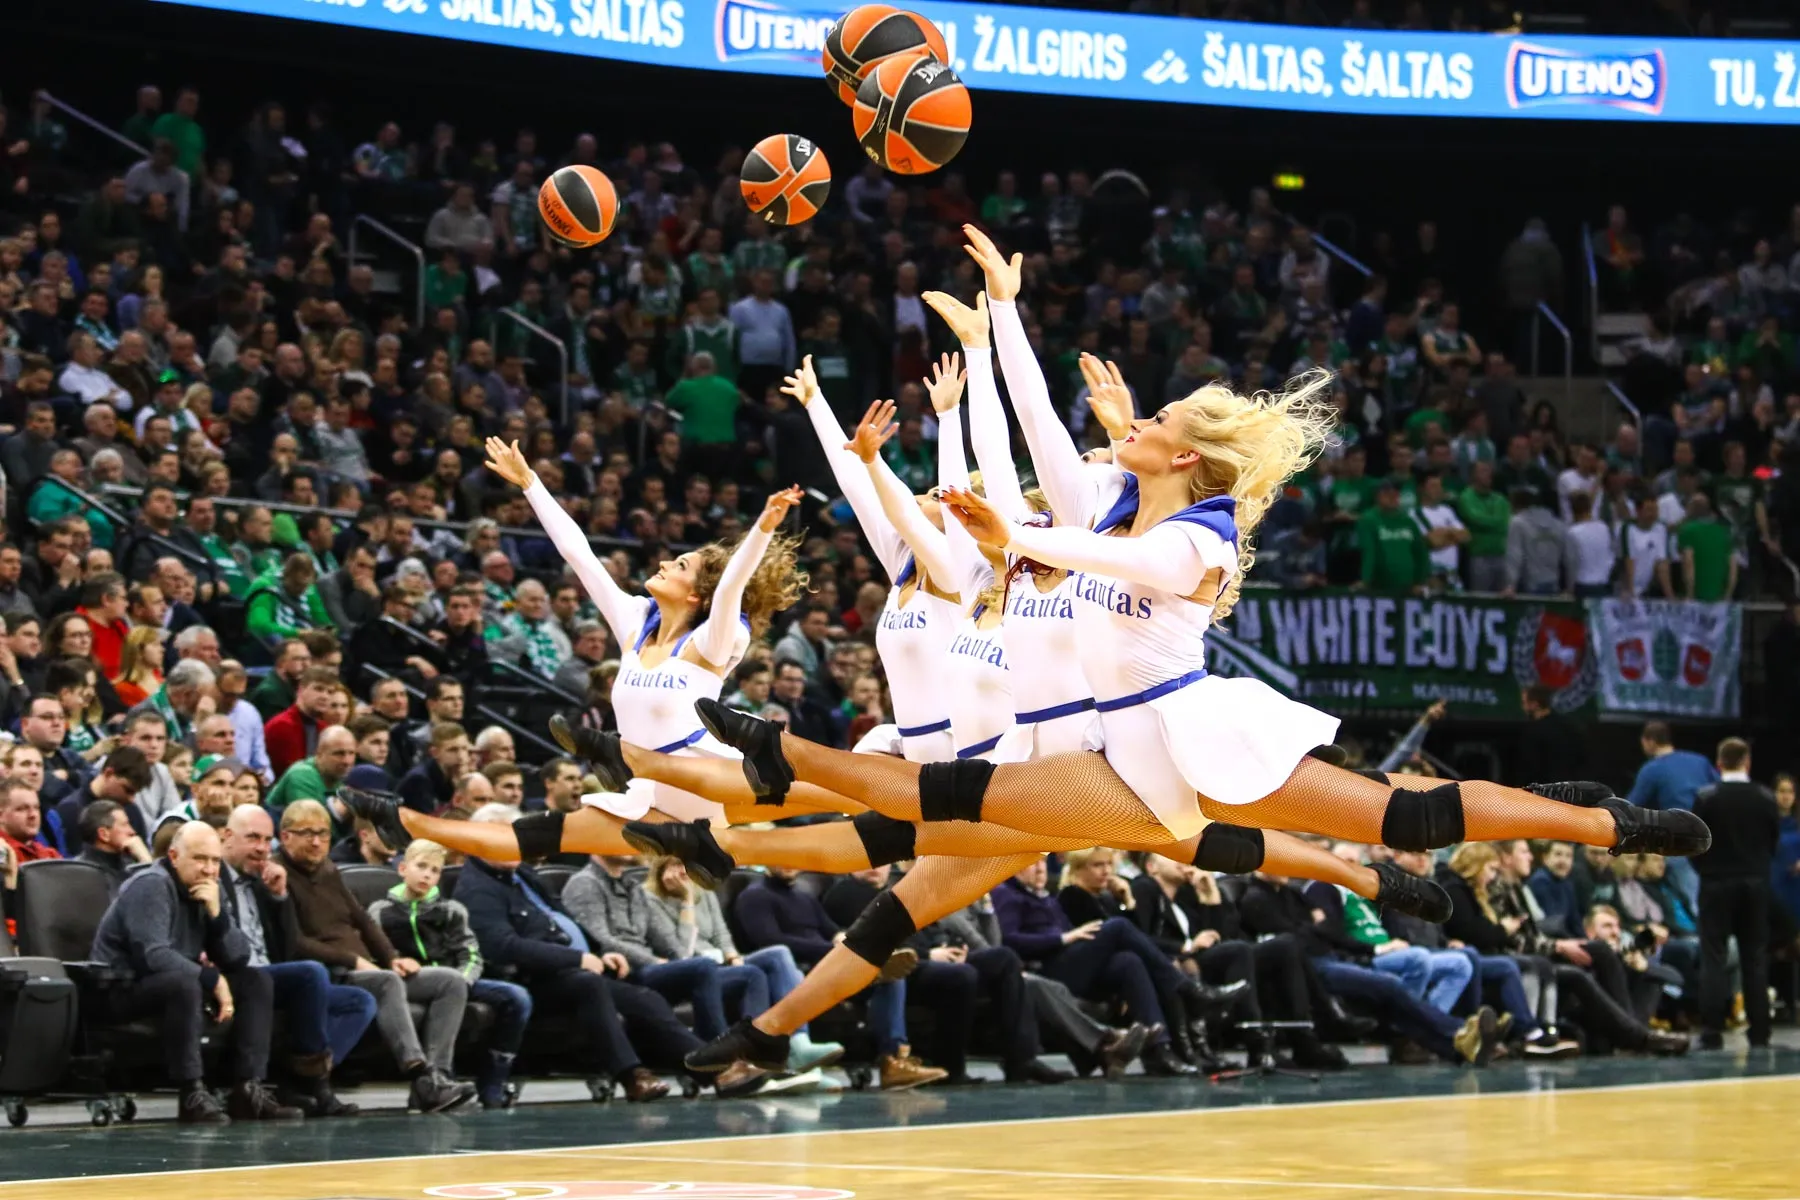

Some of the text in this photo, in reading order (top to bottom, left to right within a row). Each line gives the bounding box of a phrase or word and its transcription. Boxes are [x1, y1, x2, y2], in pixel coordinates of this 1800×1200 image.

[728, 7, 835, 51] UTENO
[971, 15, 1127, 82] ŽALGIRIS
[1142, 49, 1189, 85] ir
[1202, 31, 1334, 98] ŠALTAS,
[1341, 40, 1474, 100] ŠALTAS
[1519, 53, 1656, 100] UTENOS
[1709, 51, 1800, 110] TU, Ž
[1005, 590, 1074, 620] tauta
[1073, 571, 1152, 620] tautas
[950, 633, 1010, 672] tauta
[1268, 596, 1397, 666] WHITE
[1404, 599, 1508, 675] BOYS
